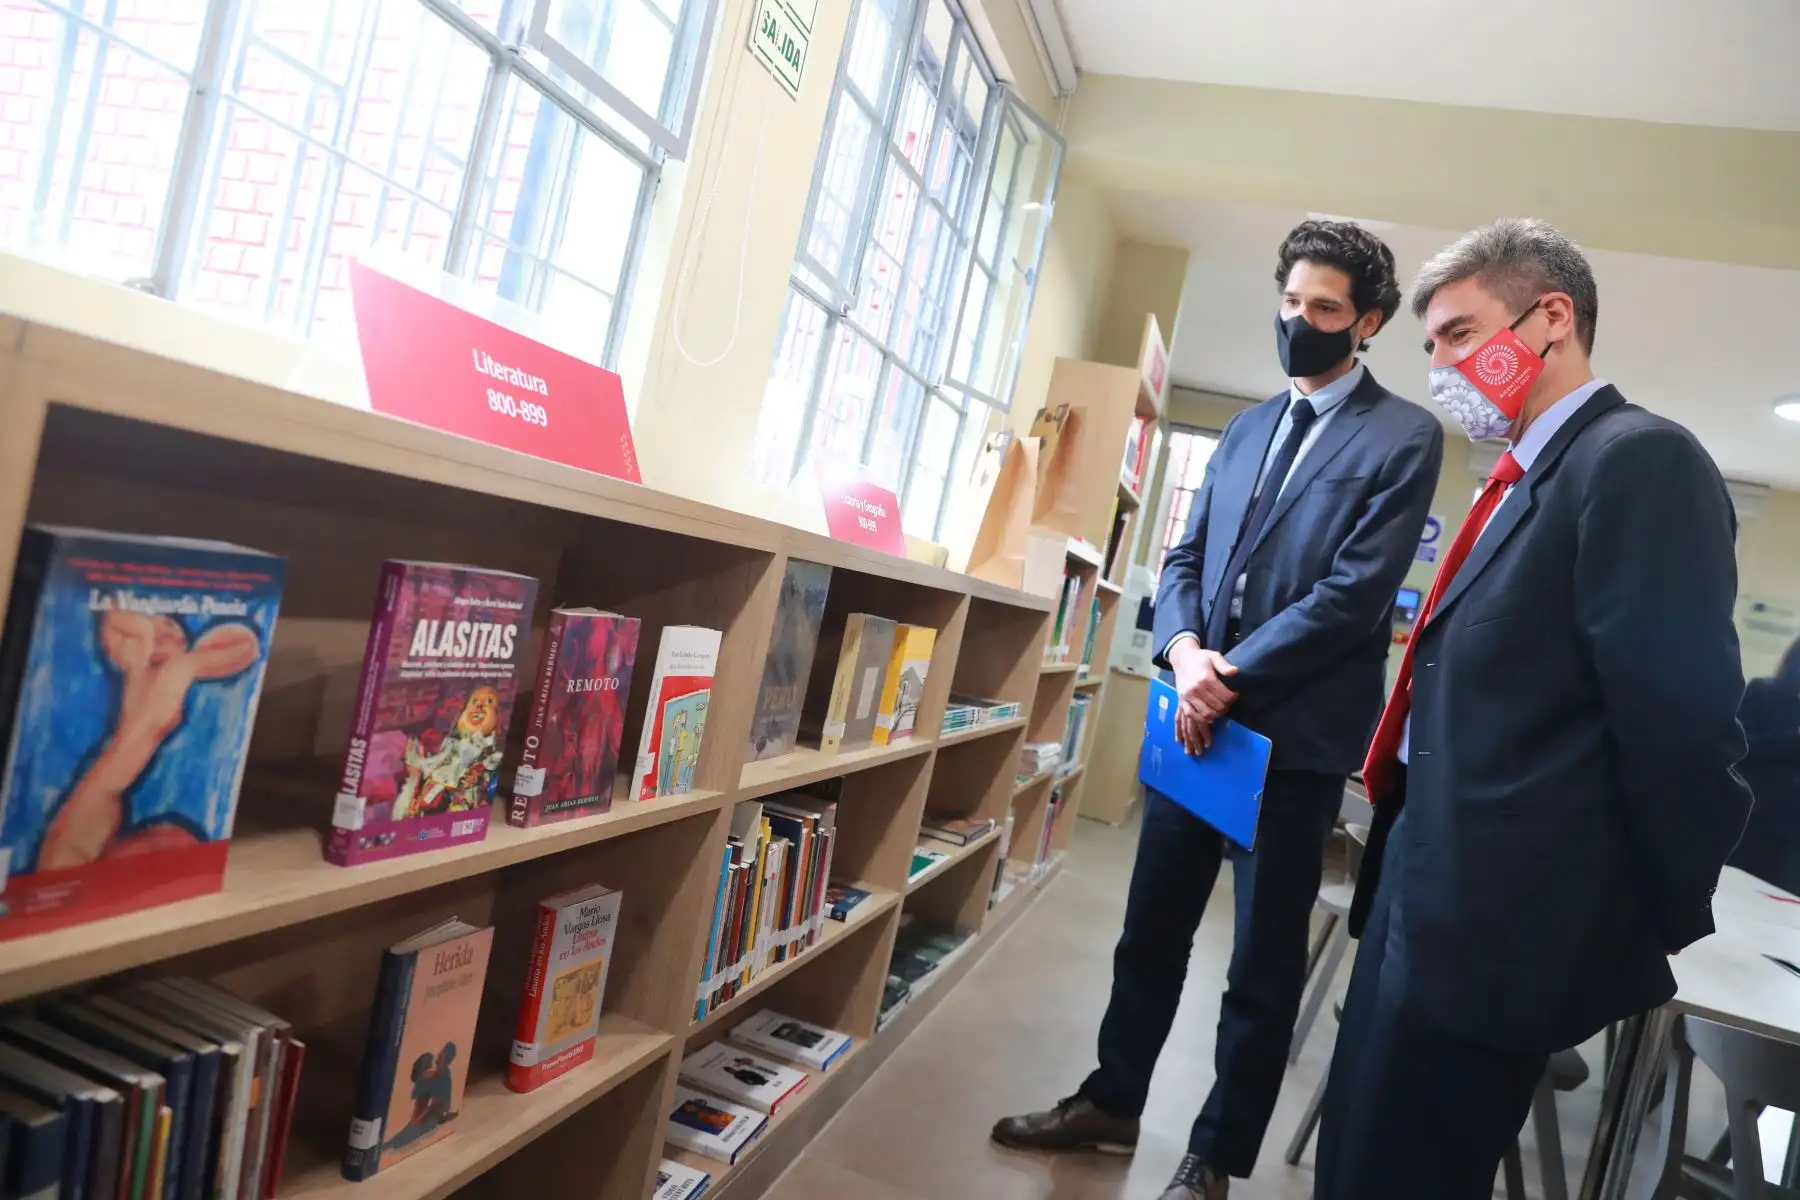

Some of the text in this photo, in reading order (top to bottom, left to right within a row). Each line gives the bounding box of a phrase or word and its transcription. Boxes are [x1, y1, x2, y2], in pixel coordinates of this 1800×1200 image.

[761, 10, 801, 73] SALIDA
[472, 348, 548, 396] Literatura
[486, 388, 548, 427] 800-899
[409, 618, 518, 660] ALASITAS
[566, 677, 620, 693] REMOTO
[342, 737, 367, 797] LASITAS
[544, 802, 559, 812] JUAN
[560, 799, 577, 808] ARIAS
[564, 912, 612, 935] Vargas Llosa
[579, 904, 601, 919] Mario
[432, 941, 474, 976] Herida
